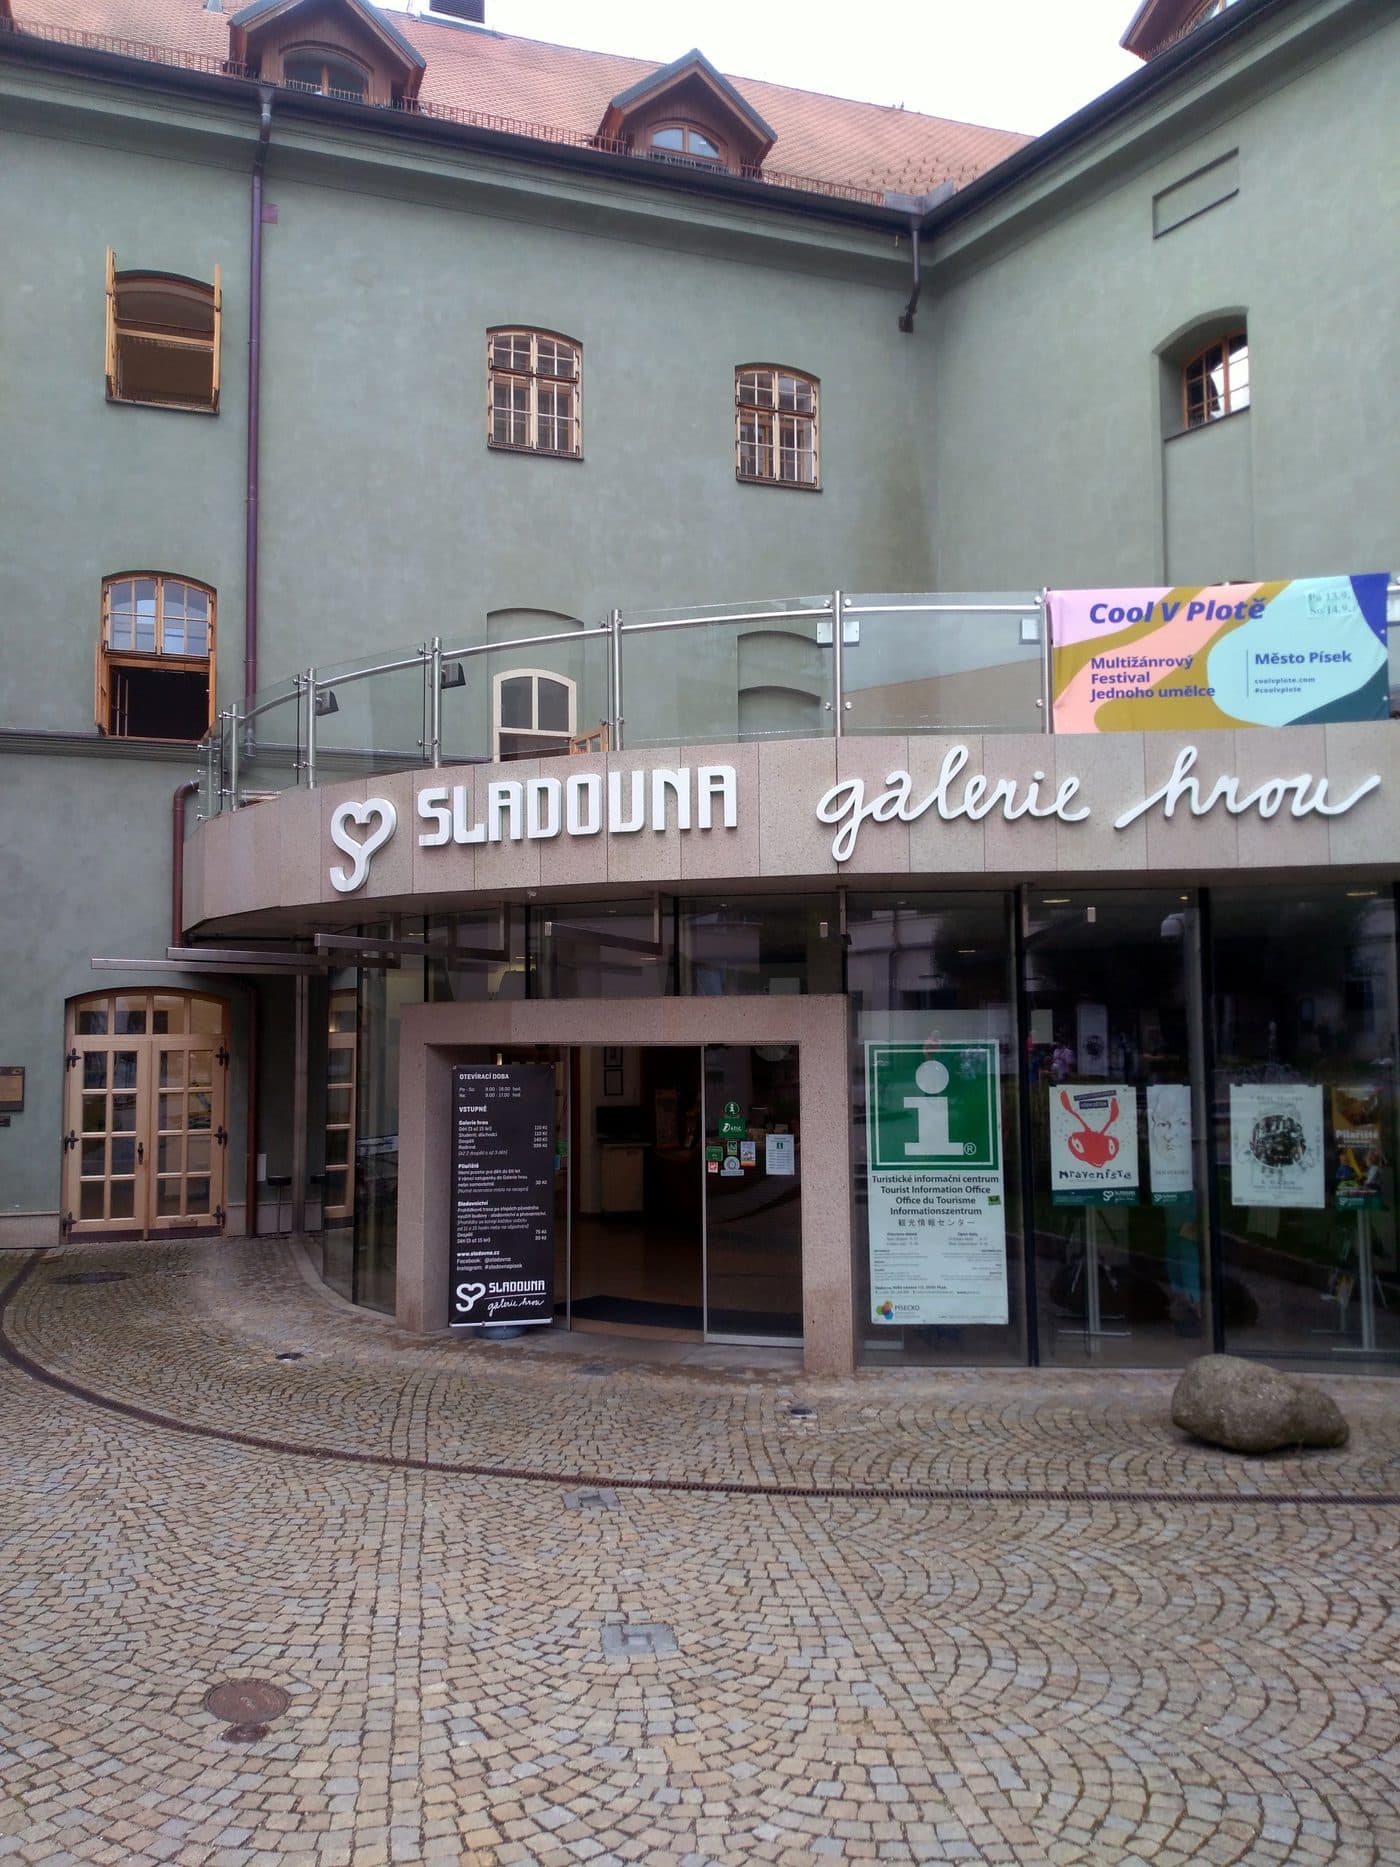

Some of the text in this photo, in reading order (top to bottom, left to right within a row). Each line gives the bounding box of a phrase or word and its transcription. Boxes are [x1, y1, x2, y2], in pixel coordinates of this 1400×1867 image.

[1089, 598, 1266, 625] Cool V Plotě
[1090, 653, 1194, 671] Multižánrový
[1255, 650, 1353, 665] Město Písek
[1091, 671, 1150, 684] Festival
[1090, 683, 1216, 702] Jednoho umělce
[815, 744, 1382, 862] galerie hrou
[459, 1071, 492, 1080] OTEVÍRACÍ
[458, 1105, 488, 1113] VSTUPNÉ
[871, 1174, 1000, 1183] Turistické informační centrum
[881, 1185, 991, 1194] Tourist Information Office
[895, 1196, 976, 1205] Office du Tourisme
[890, 1207, 983, 1216] Informationszentrum
